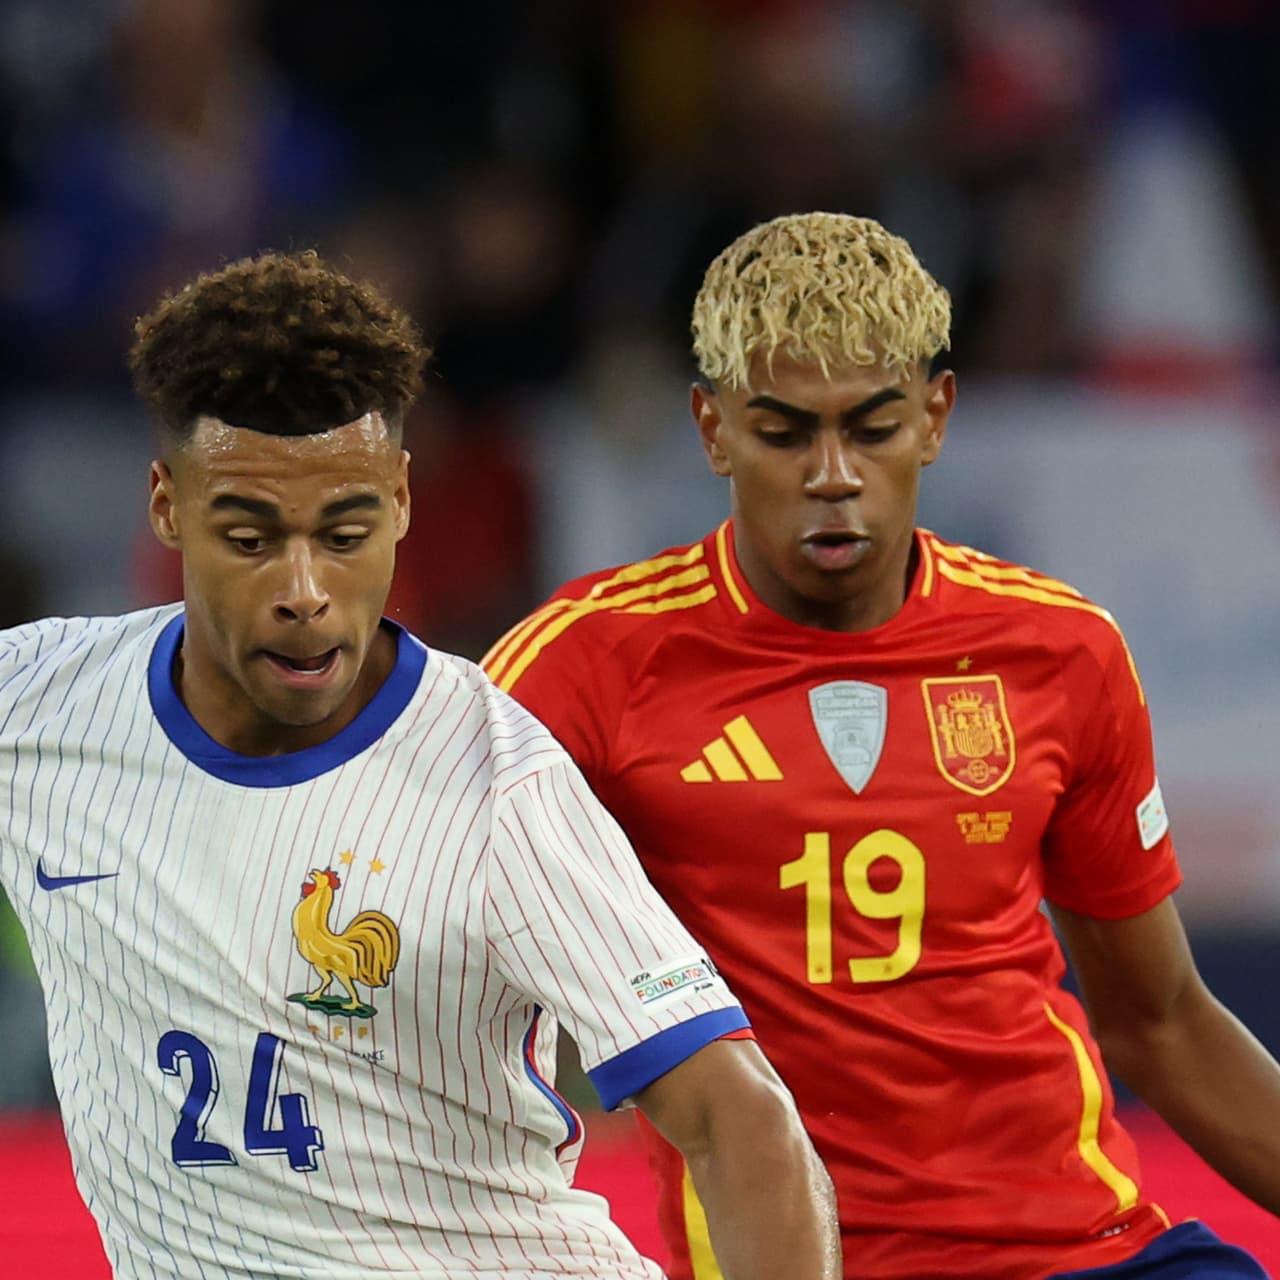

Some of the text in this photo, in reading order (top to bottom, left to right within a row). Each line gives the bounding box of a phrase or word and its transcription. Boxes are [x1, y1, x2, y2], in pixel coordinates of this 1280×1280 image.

[779, 829, 926, 984] 19
[636, 967, 706, 1000] FOUNDATION
[156, 1030, 324, 1172] 24
